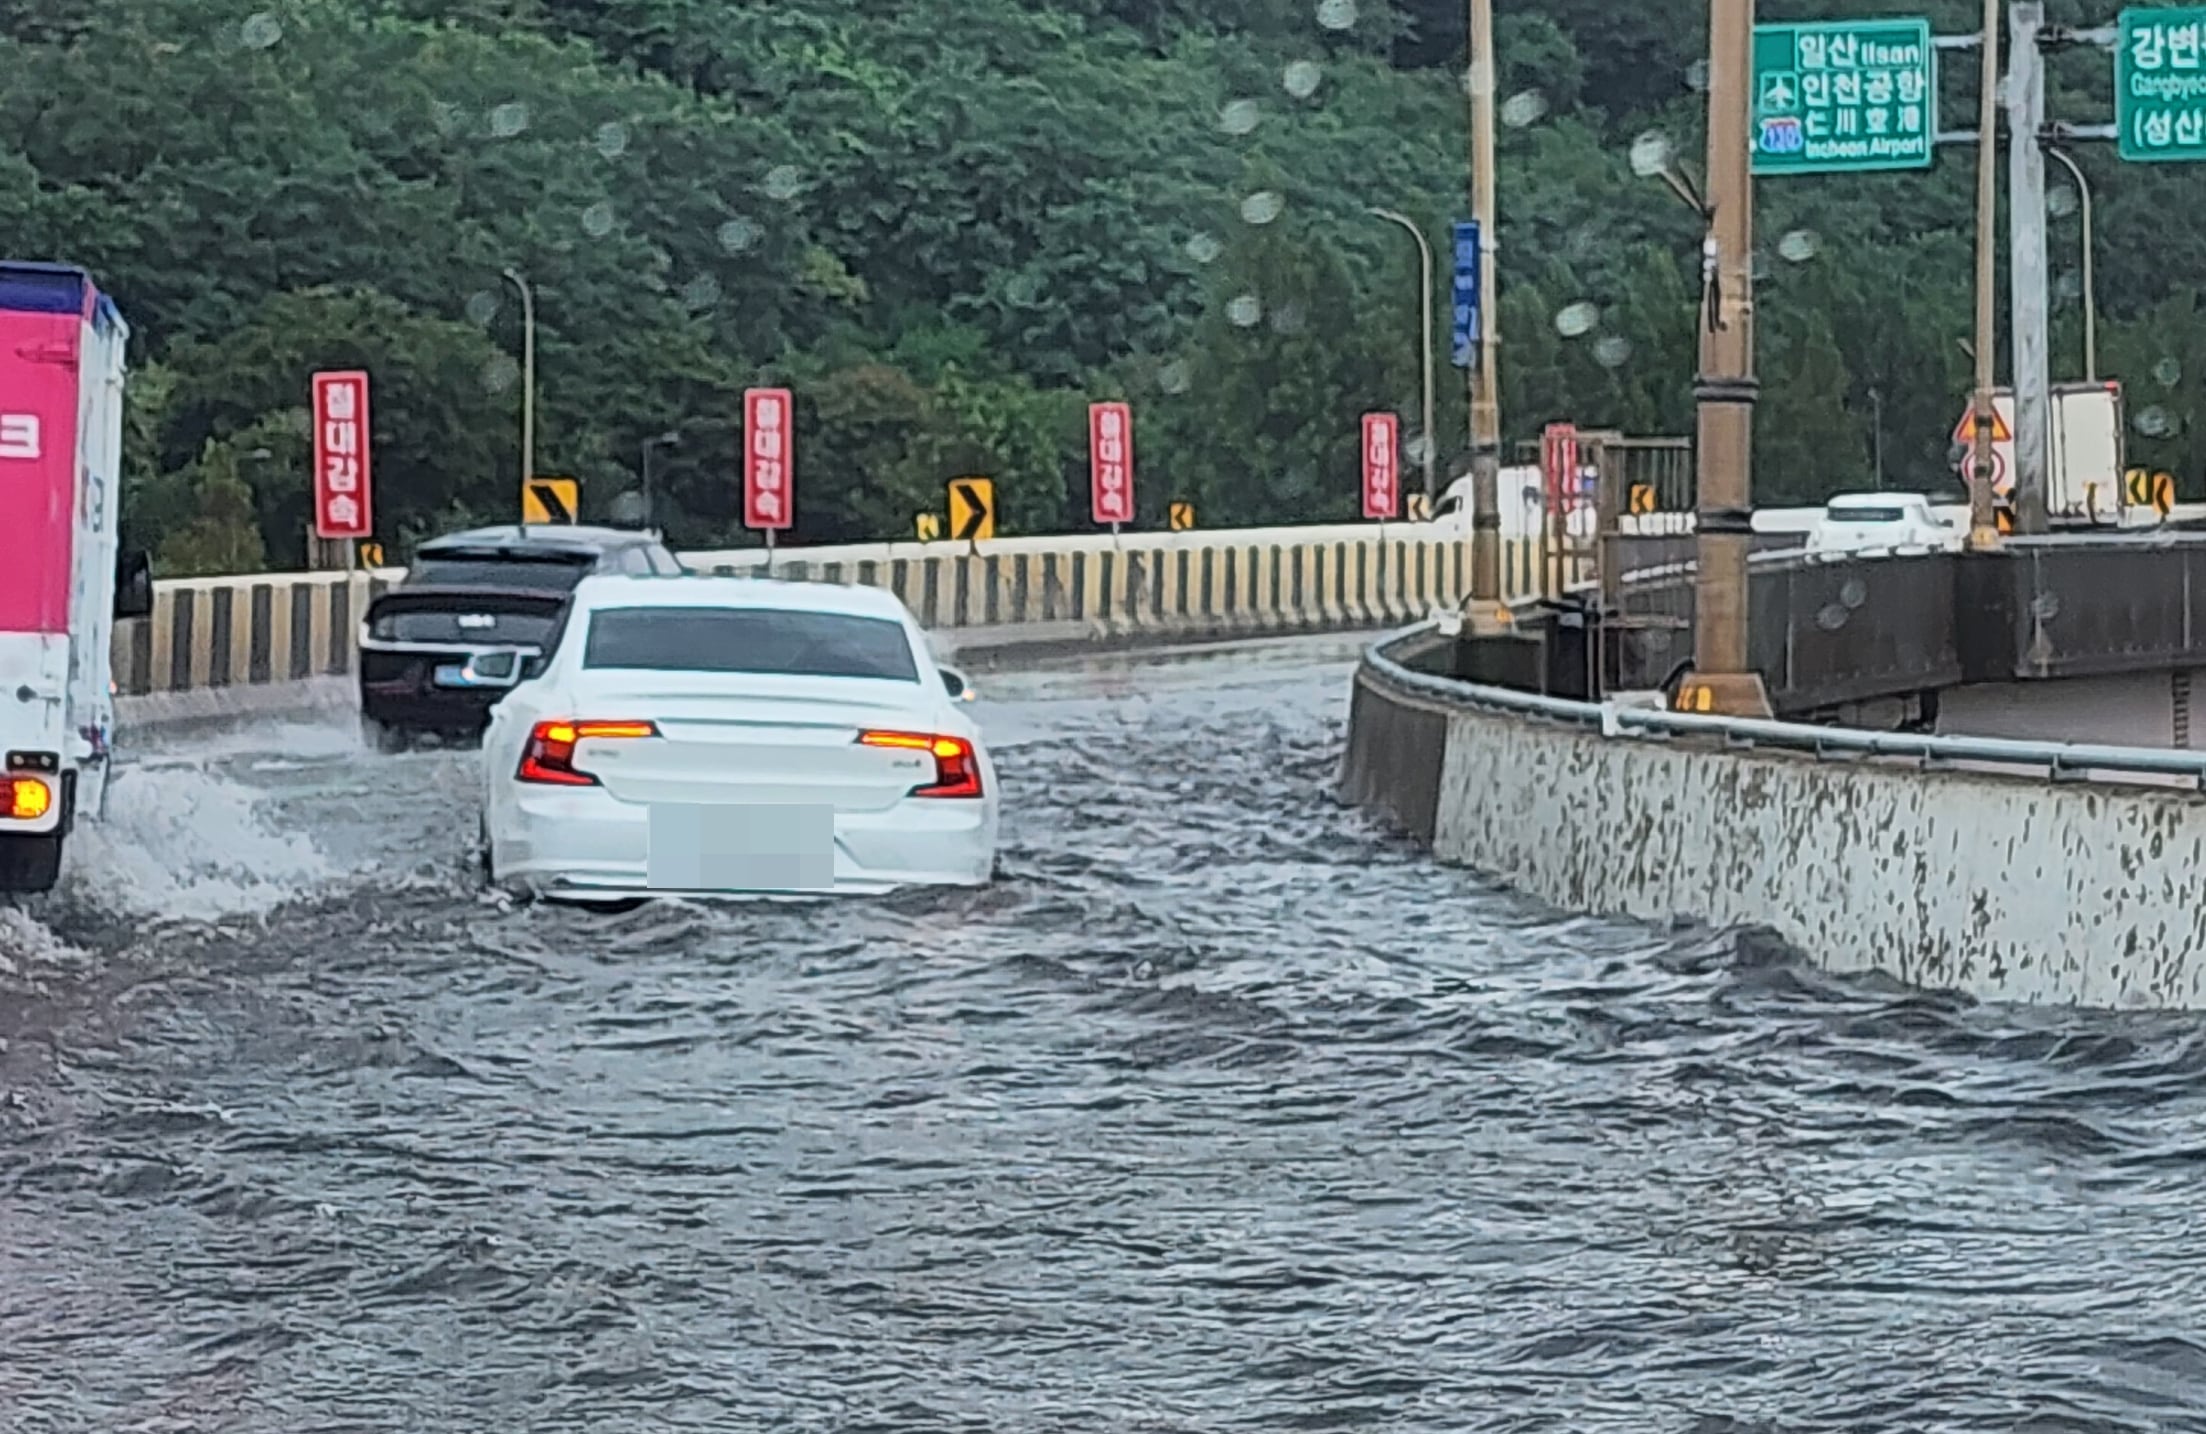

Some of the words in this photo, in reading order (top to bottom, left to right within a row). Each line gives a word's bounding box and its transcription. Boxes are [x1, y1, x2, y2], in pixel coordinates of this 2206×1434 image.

[1799, 34, 1858, 68] 일산
[1861, 41, 1919, 65] Ilsan
[2132, 23, 2206, 69] 강변
[1802, 70, 1924, 106] 인천공항
[2134, 107, 2206, 147] (성산
[1805, 138, 1868, 158] Incheon
[1869, 135, 1923, 159] Airport
